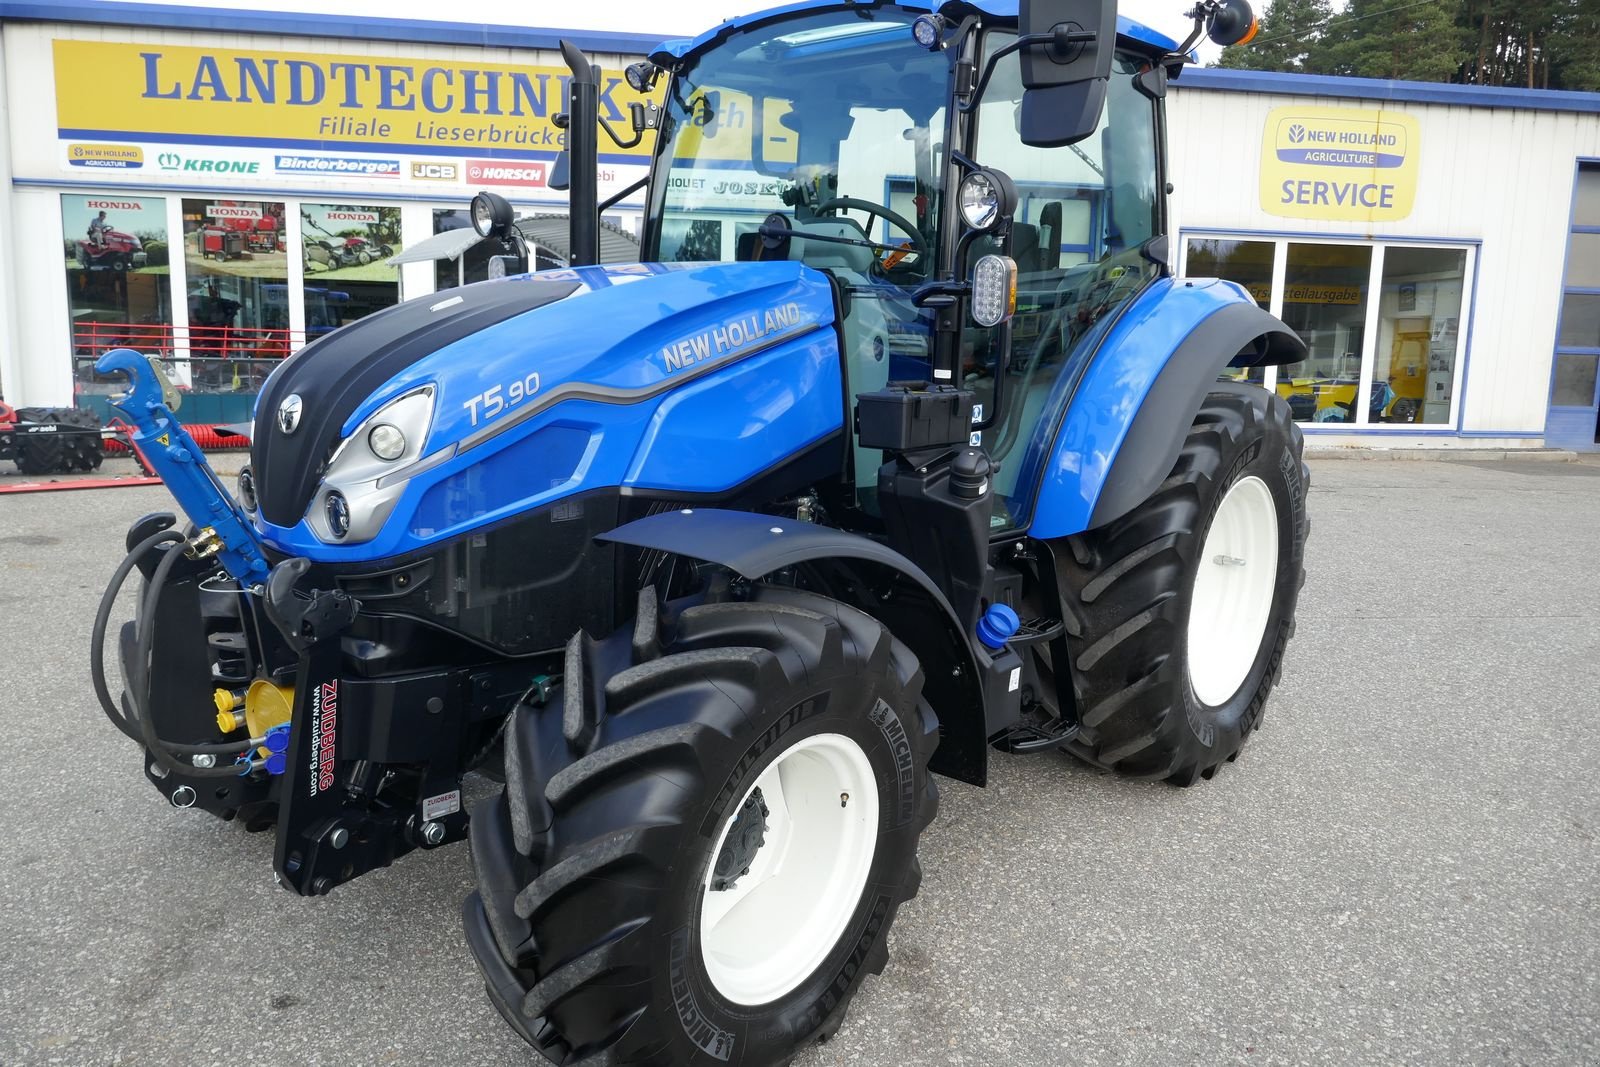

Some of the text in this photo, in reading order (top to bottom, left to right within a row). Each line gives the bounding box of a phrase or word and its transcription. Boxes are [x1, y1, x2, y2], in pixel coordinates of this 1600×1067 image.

[139, 52, 626, 121] LANDTECHNIK
[318, 116, 391, 138] Filiale
[1308, 130, 1397, 146] NEW HOLLAND
[85, 149, 138, 159] NEW HOLLAND
[1305, 151, 1375, 165] AGRICULTURE
[85, 159, 127, 168] AGRICULTURE
[183, 159, 260, 174] KRONE
[278, 156, 397, 174] Binderberger
[414, 164, 455, 179] JCB
[482, 168, 541, 182] HORSCH
[597, 170, 615, 182] ebi
[1281, 179, 1395, 209] SERVICE
[87, 200, 142, 211] HONDA
[208, 207, 260, 218] HONDA
[326, 211, 376, 222] HONDA
[661, 302, 801, 374] NEW HOLLAND
[463, 372, 541, 427] T5.90
[310, 685, 320, 798] www.zuidberg.com
[319, 678, 338, 792] ZUIDBERG
[885, 718, 914, 822] MICHELIN
[671, 937, 717, 1049] MICHELIN
